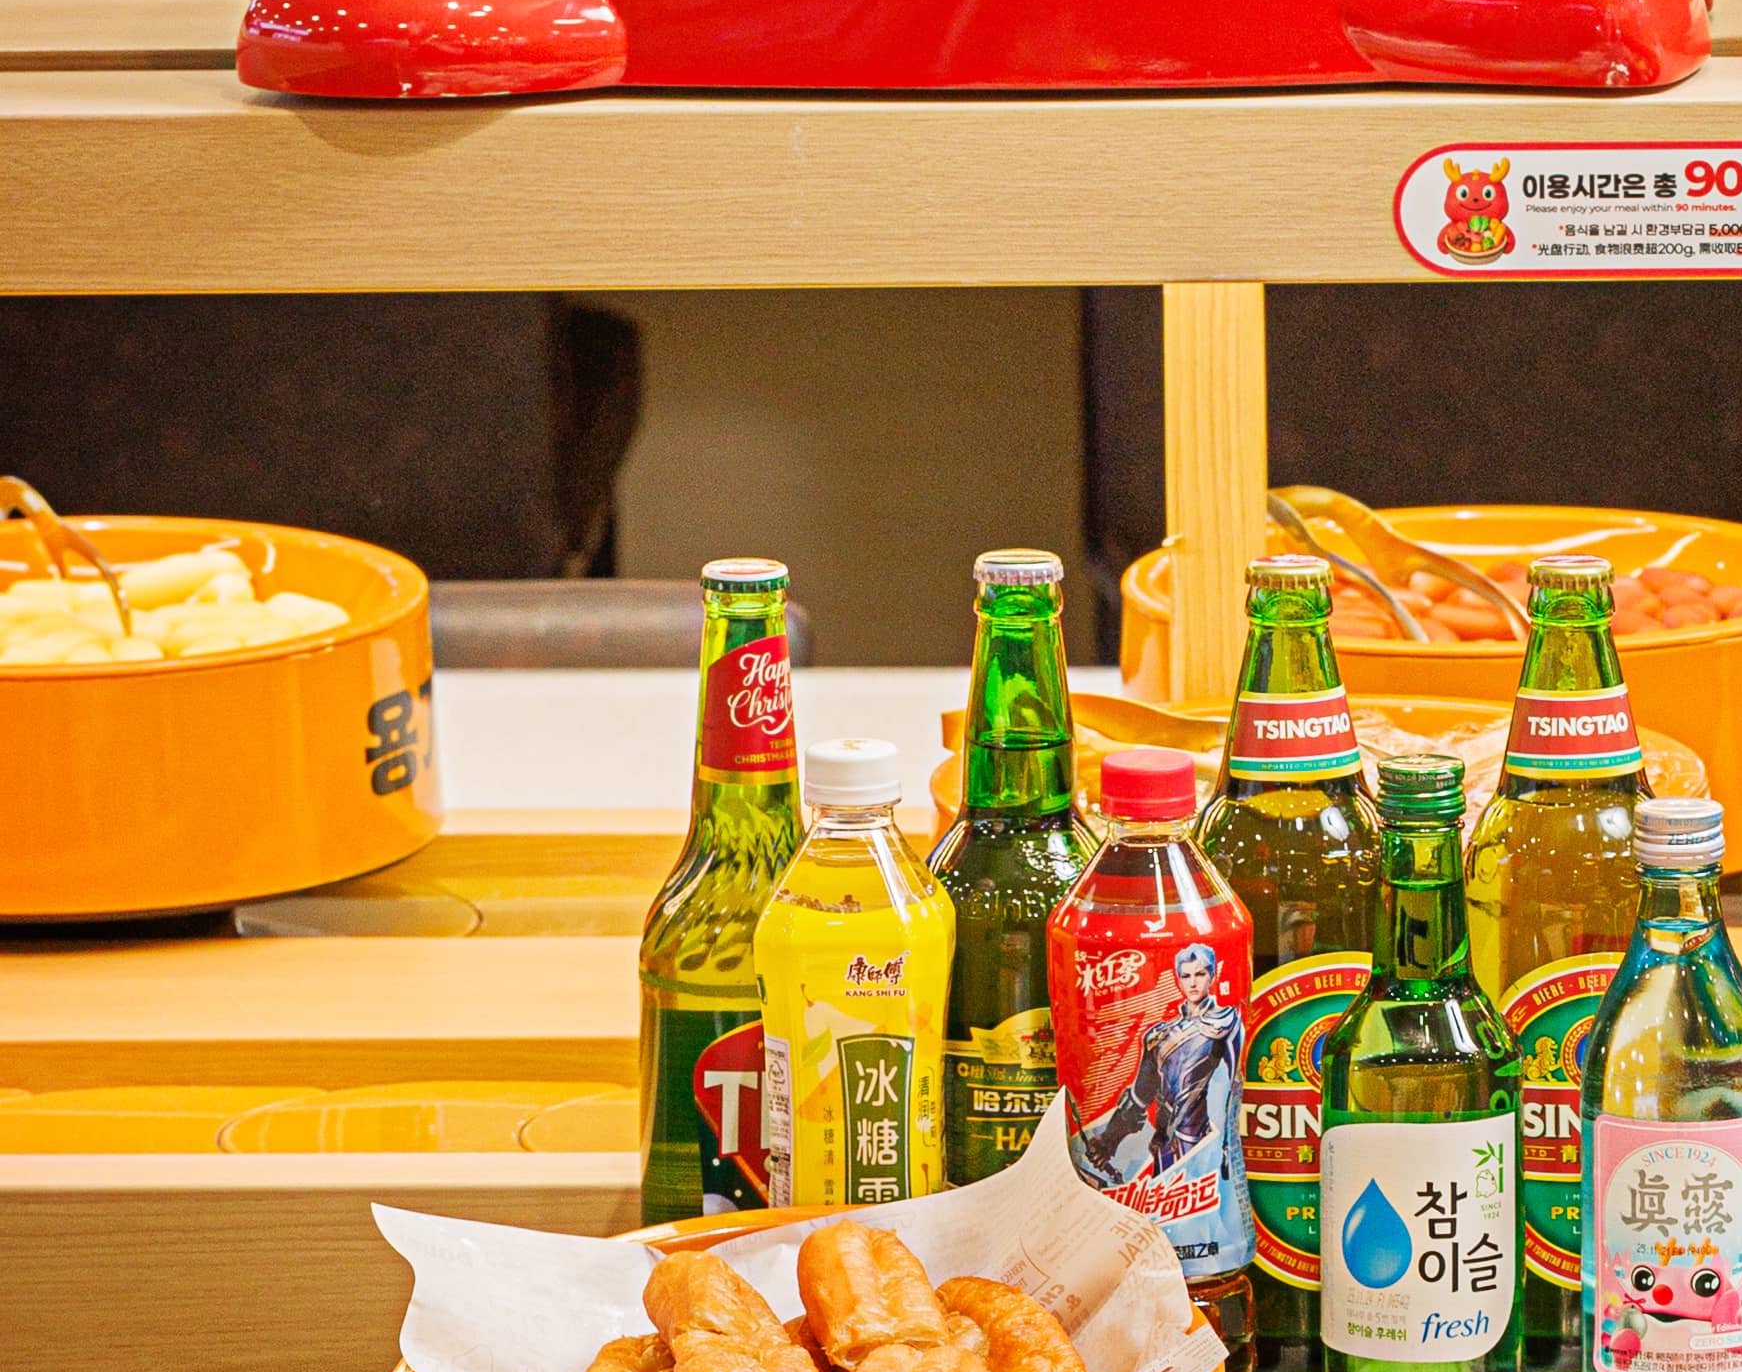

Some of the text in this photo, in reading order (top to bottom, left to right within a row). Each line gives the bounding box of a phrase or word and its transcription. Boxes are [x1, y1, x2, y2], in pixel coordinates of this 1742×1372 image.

[1523, 174, 1645, 199] 이용시간은
[1653, 173, 1677, 199] 총
[1525, 202, 1736, 214] Please enjoy your meal within 90 minutes.
[1631, 224, 1643, 235] 시
[1253, 712, 1351, 740] TSINGTAO
[1527, 711, 1629, 737] TSINGTAO
[1075, 949, 1146, 996] 冰红茶
[845, 988, 906, 998] KANG SHI FU
[1269, 972, 1343, 1008] BIERE BEER
[1532, 980, 1565, 1007] BIERE
[1640, 1146, 1717, 1168] SINCE 1924
[1414, 1181, 1468, 1239] 참
[1418, 1232, 1504, 1293] 이슬
[1347, 1321, 1407, 1342] 참이슬 후레쉬
[1421, 1309, 1490, 1343] fresh
[1695, 1336, 1725, 1348] ZERO
